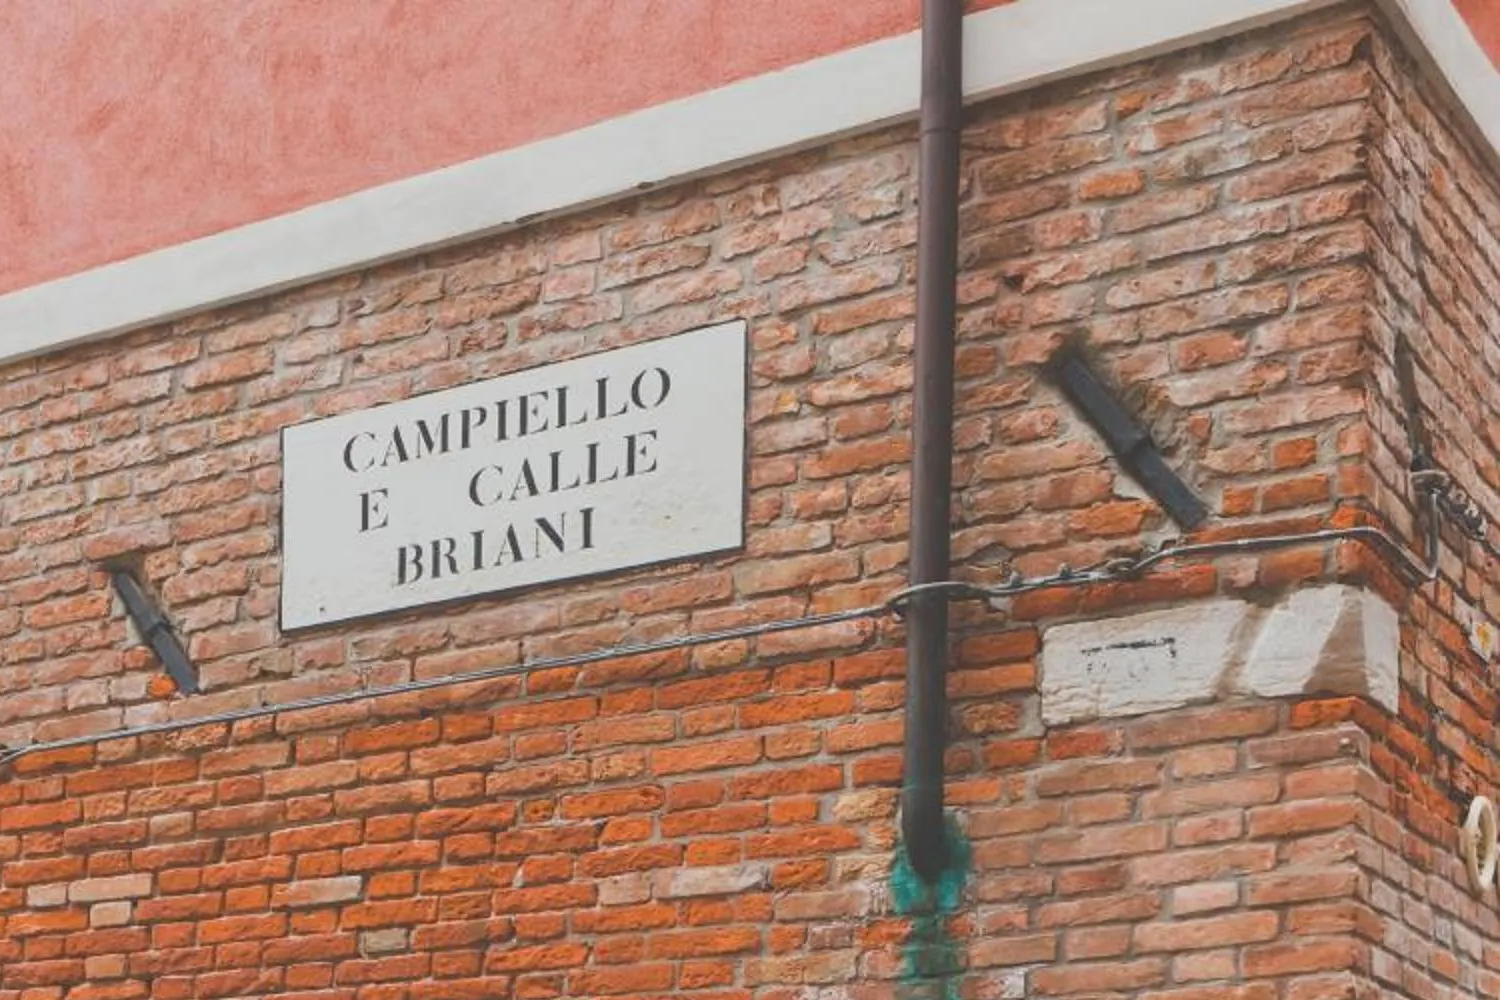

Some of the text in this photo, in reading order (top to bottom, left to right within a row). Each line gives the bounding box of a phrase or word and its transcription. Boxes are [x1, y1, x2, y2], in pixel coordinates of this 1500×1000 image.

[343, 367, 671, 473] CAMPIELLO
[359, 430, 658, 533] E CALLE
[397, 508, 595, 585] BRIANI
